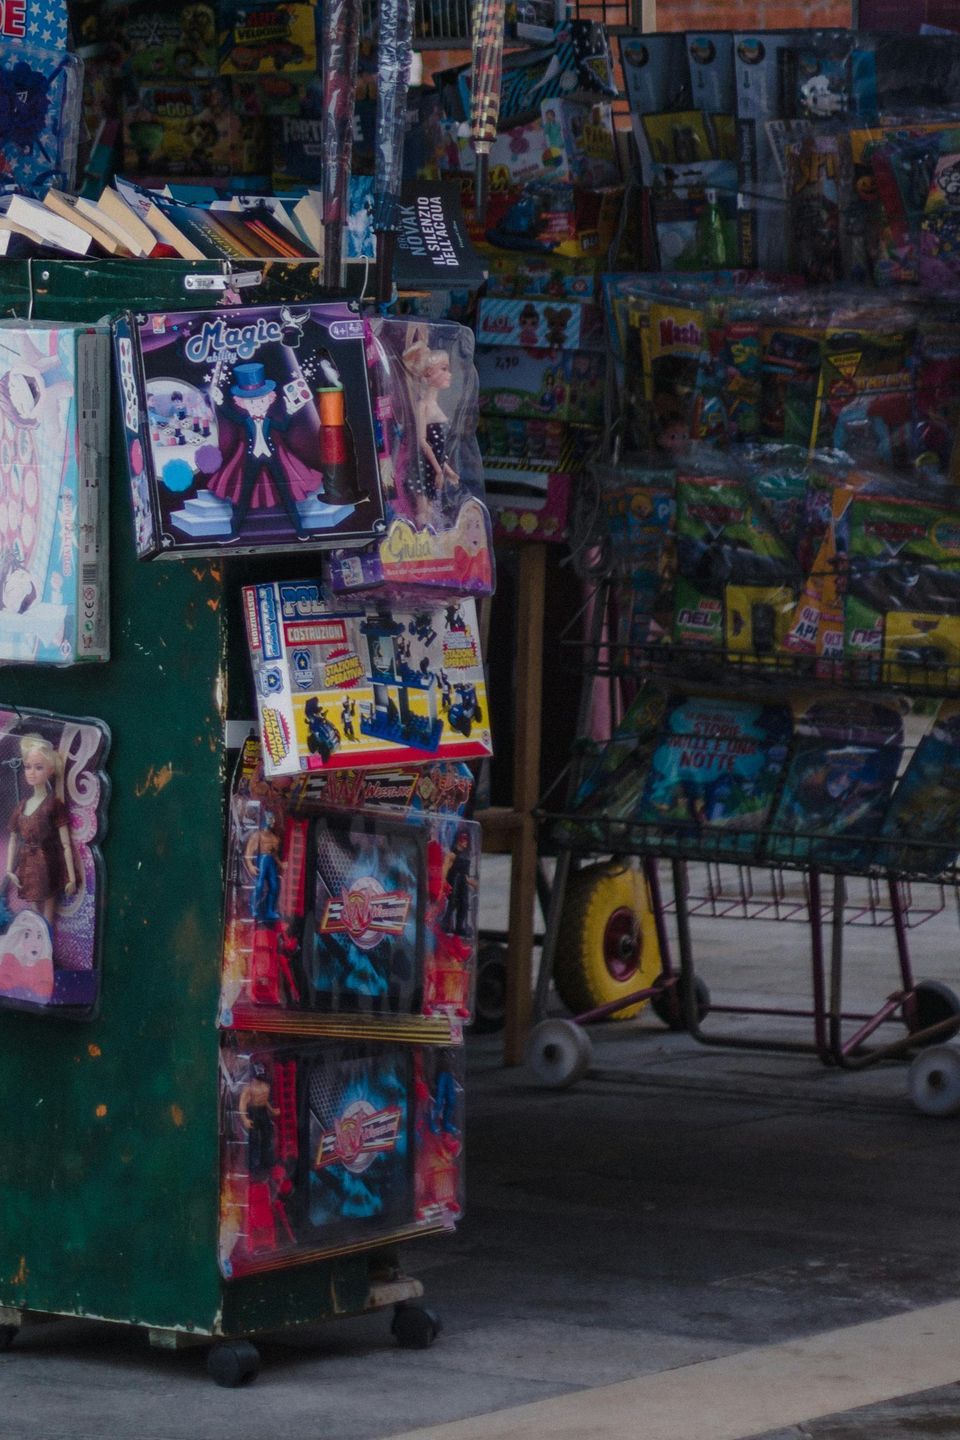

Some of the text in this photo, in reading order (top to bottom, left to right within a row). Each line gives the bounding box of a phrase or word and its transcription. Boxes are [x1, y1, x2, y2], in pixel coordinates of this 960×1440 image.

[395, 203, 427, 256] NOVAK
[417, 196, 446, 265] IL SILENZIO
[429, 196, 459, 266] DELL'ACQUA
[185, 317, 282, 362] Magic
[206, 349, 239, 364] ability
[389, 525, 433, 559] Giulia
[325, 656, 360, 677] STAZIONE
